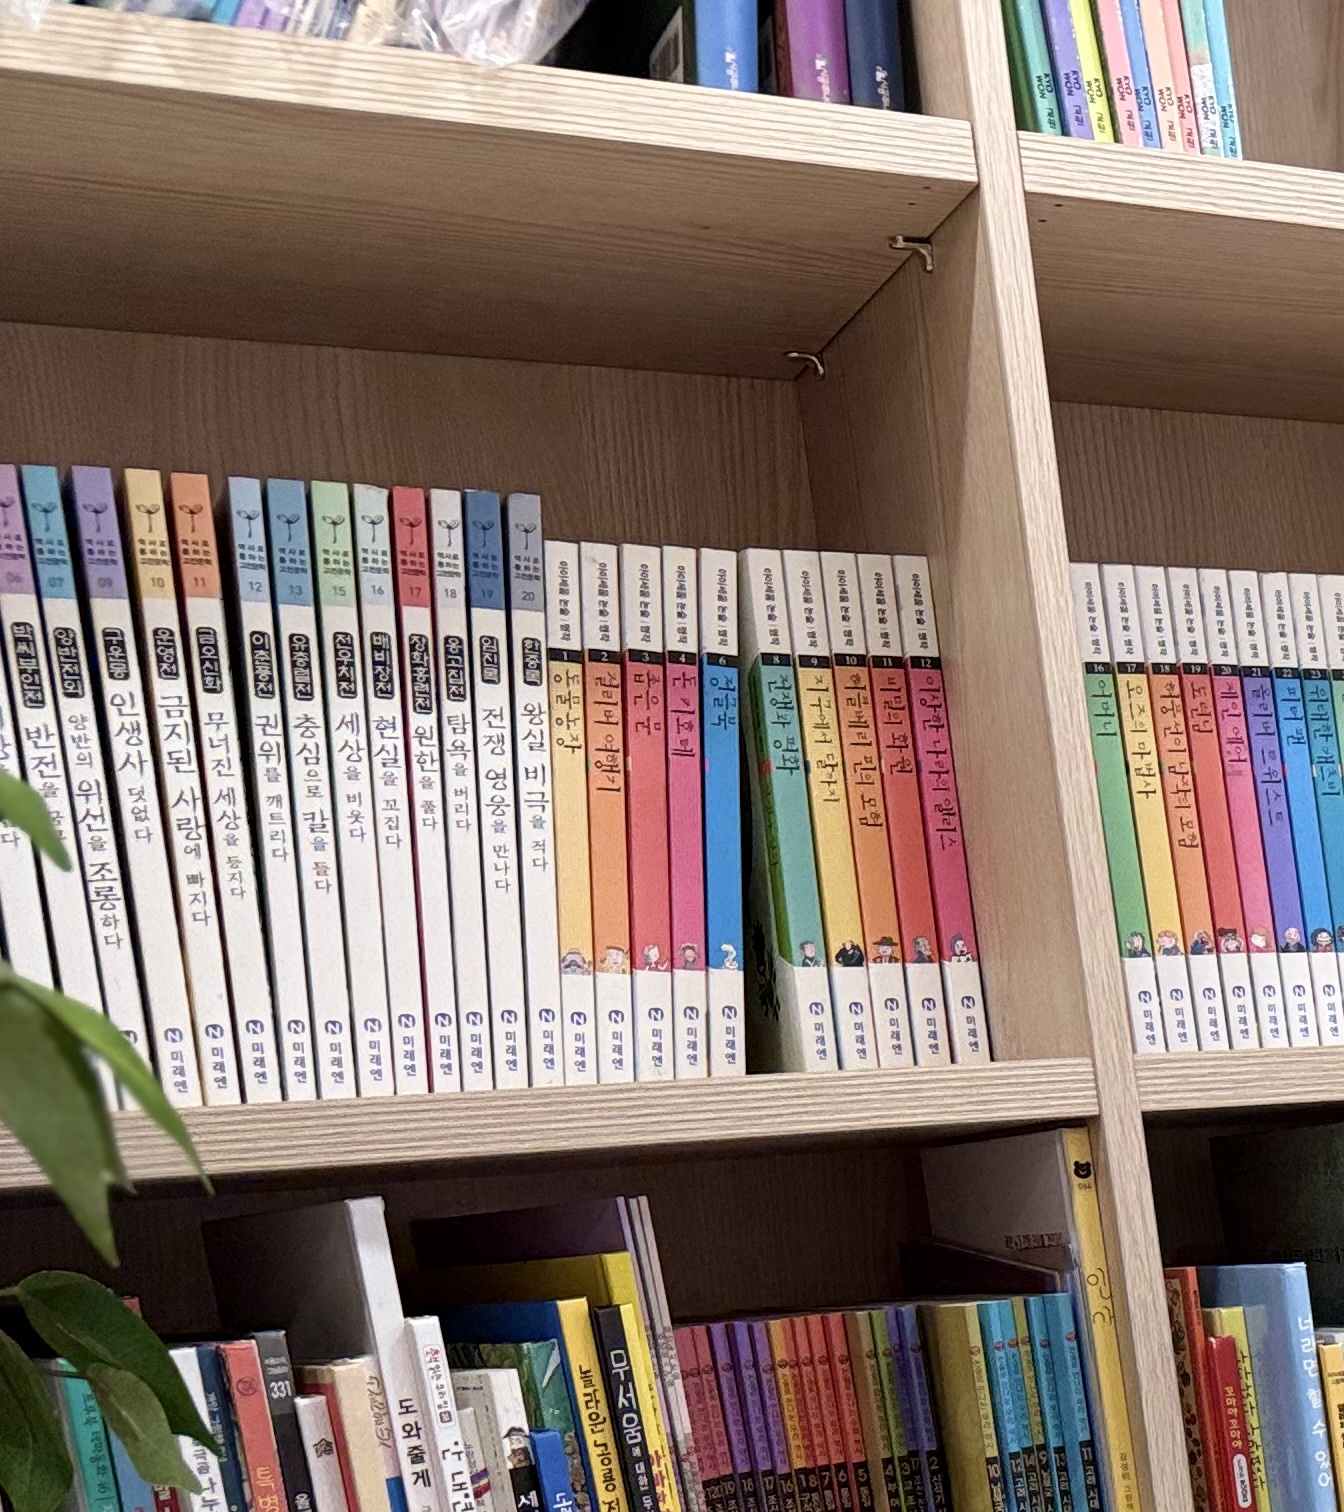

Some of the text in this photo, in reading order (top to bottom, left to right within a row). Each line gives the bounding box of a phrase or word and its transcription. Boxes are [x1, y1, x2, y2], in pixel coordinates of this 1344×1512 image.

[248, 582, 263, 593] 12
[522, 590, 535, 602] 20
[157, 696, 196, 776] 금지된
[523, 702, 548, 753] 왕실
[552, 669, 582, 754] 동물농장
[594, 670, 621, 794] 걸리버 여행기
[633, 670, 661, 737] 좁은 문
[709, 675, 737, 731] 정글북
[768, 673, 800, 776] 전쟁과 평화
[805, 674, 840, 804] 지구에서 달까지
[878, 676, 913, 776] 비밀의 화원
[1091, 680, 1117, 738] 어머니
[1127, 680, 1157, 799] 오즈의 마법사
[1219, 682, 1248, 764] 제인 에어
[108, 692, 154, 843] 인생사 덧없다
[204, 713, 234, 778] 무너진
[335, 714, 367, 842] 세상을 비웃다
[373, 716, 402, 786] 현실을
[413, 724, 440, 791] 원한을
[445, 714, 472, 831] 탐욕을 버리다
[918, 676, 958, 852] 이상한 나라의 앨리스
[171, 787, 206, 860] 사랑에
[213, 789, 241, 846] 세상을
[265, 794, 290, 862] 깨트리다
[302, 809, 330, 853] 칼을
[479, 709, 513, 893] 전쟁 영웅을 만나다
[525, 766, 550, 830] 비극을
[87, 861, 125, 951] 조롱하다
[542, 1029, 556, 1070] 미래엔
[578, 1365, 604, 1435] 놀라운
[398, 1398, 432, 1489] 도와줄게
